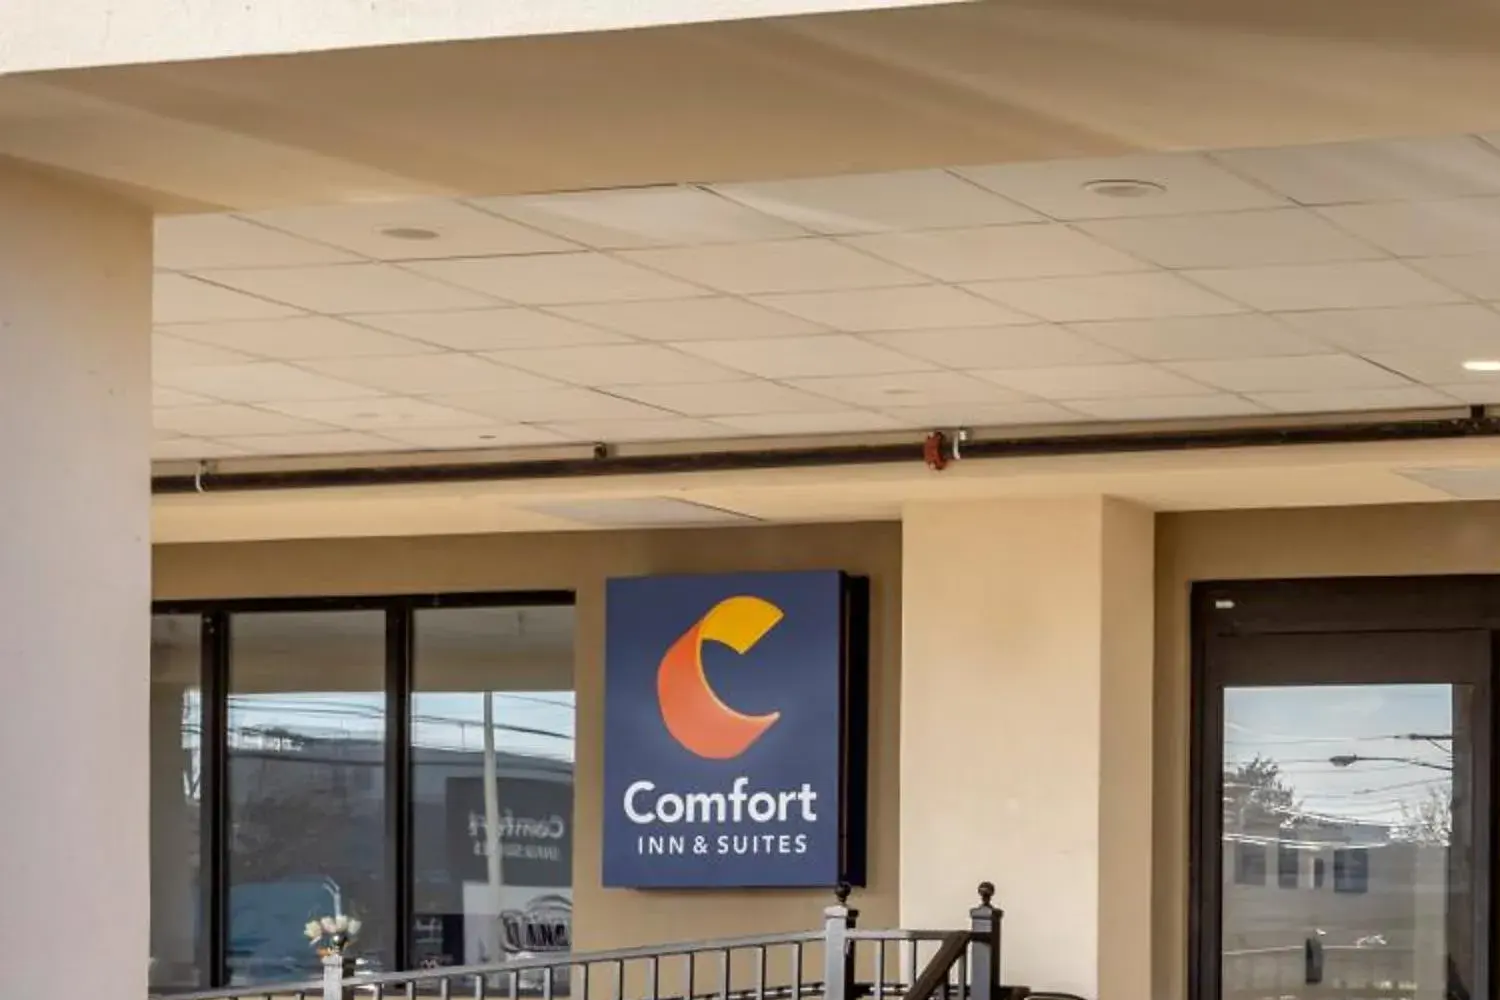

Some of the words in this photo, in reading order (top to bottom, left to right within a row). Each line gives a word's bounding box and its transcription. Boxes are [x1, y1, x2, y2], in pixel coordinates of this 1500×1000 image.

[623, 776, 818, 825] Comfort
[637, 836, 685, 855] INN
[692, 836, 709, 855] &
[716, 833, 808, 854] SUITES
